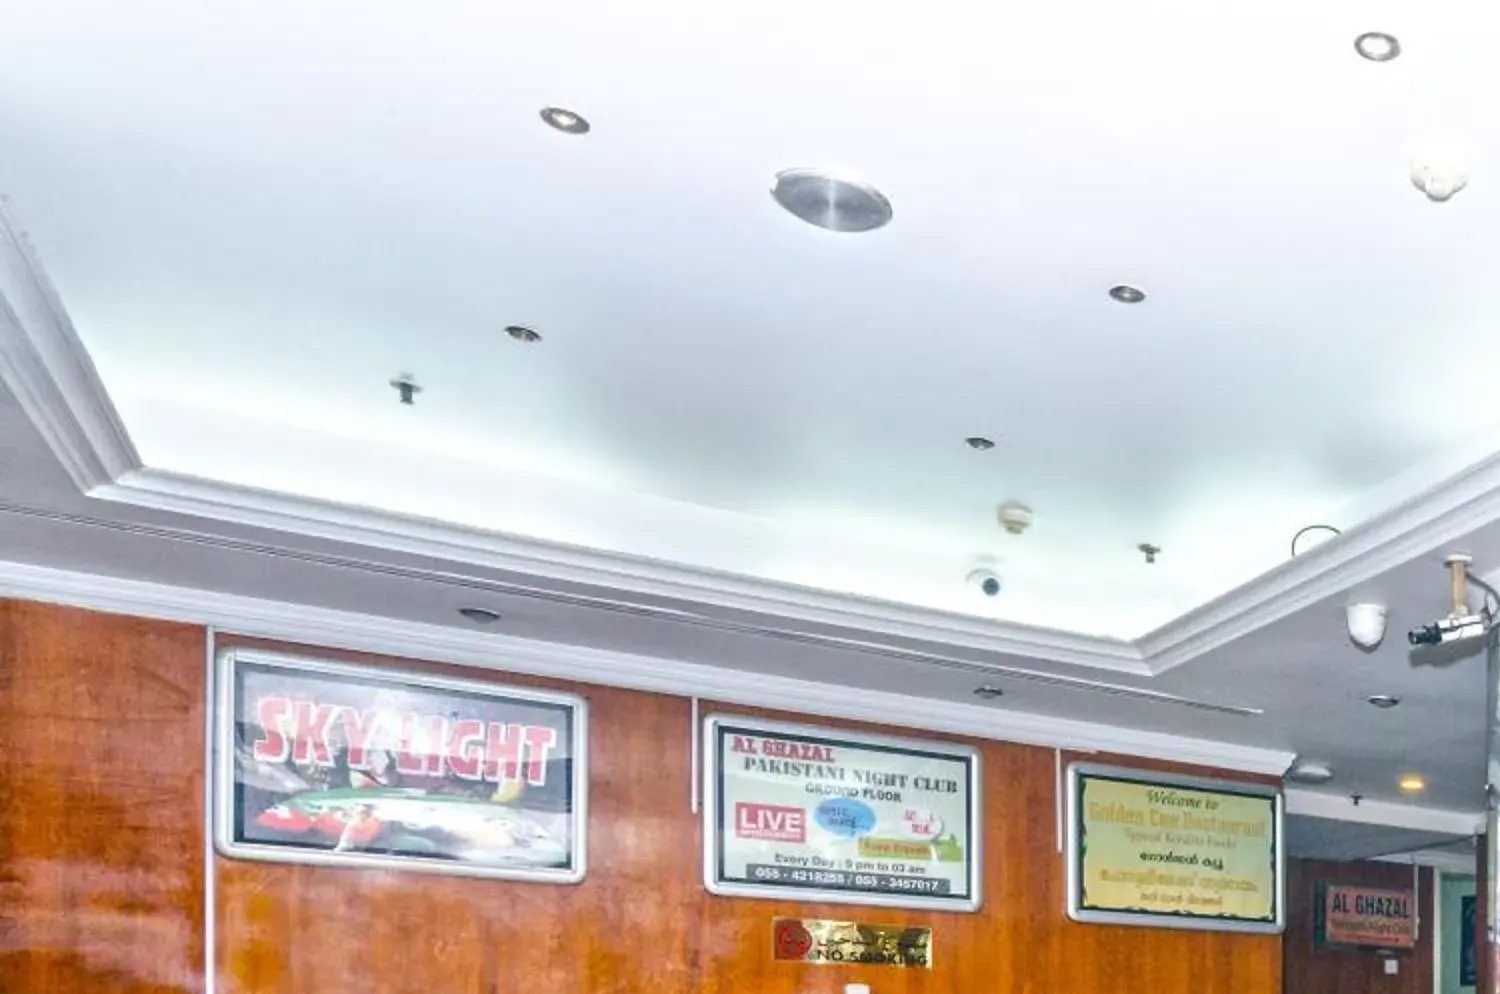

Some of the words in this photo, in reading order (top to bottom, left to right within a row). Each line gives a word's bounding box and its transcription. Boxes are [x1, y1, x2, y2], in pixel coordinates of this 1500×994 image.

[254, 696, 379, 768] SKY
[395, 711, 557, 787] LIGHT
[731, 736, 757, 753] AL
[762, 739, 836, 763] GHAZAL
[743, 757, 845, 781] PAKISTANI
[852, 768, 908, 788] NIGHT
[913, 776, 958, 794] CLUB
[805, 782, 859, 798] GROUND
[862, 788, 903, 803] FLOOR
[1147, 789, 1203, 808] Welcome
[739, 808, 801, 833] LIVE
[774, 853, 809, 867] Every
[812, 855, 835, 869] Day
[855, 860, 875, 872] pm
[876, 861, 889, 872] to
[1332, 893, 1350, 913] AL
[1355, 894, 1410, 919] GHAZAL
[816, 949, 843, 961] NO
[850, 951, 928, 967] SMOKING
